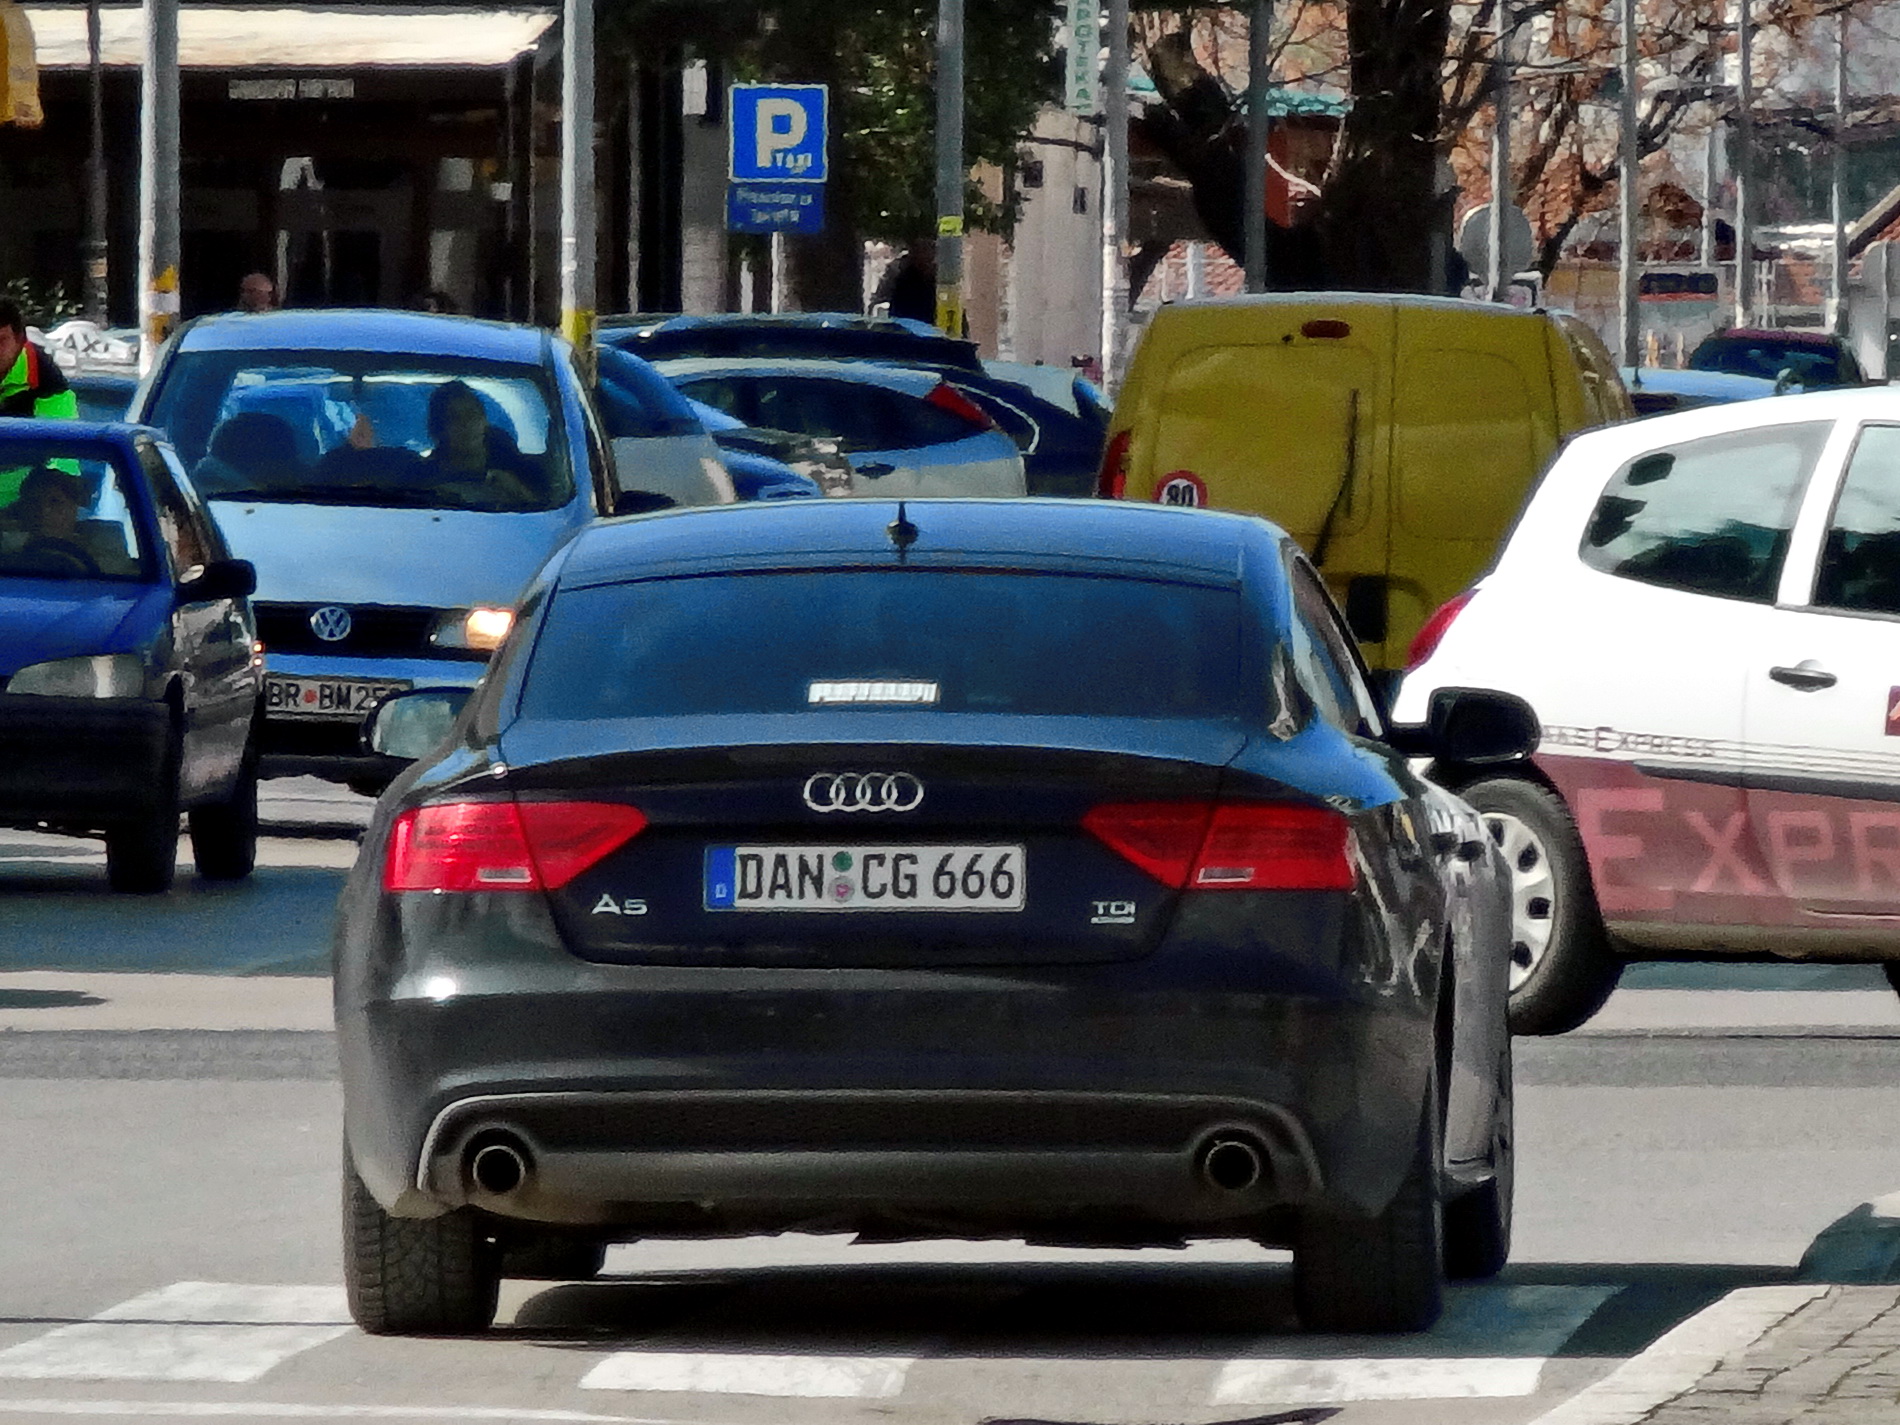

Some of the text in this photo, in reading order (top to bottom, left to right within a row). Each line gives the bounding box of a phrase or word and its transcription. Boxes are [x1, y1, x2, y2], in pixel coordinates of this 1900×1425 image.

[756, 97, 807, 168] P
[267, 681, 301, 708] BR
[737, 852, 824, 900] DAN
[861, 852, 917, 899] CG
[932, 852, 1015, 899] 666
[591, 893, 648, 915] A5
